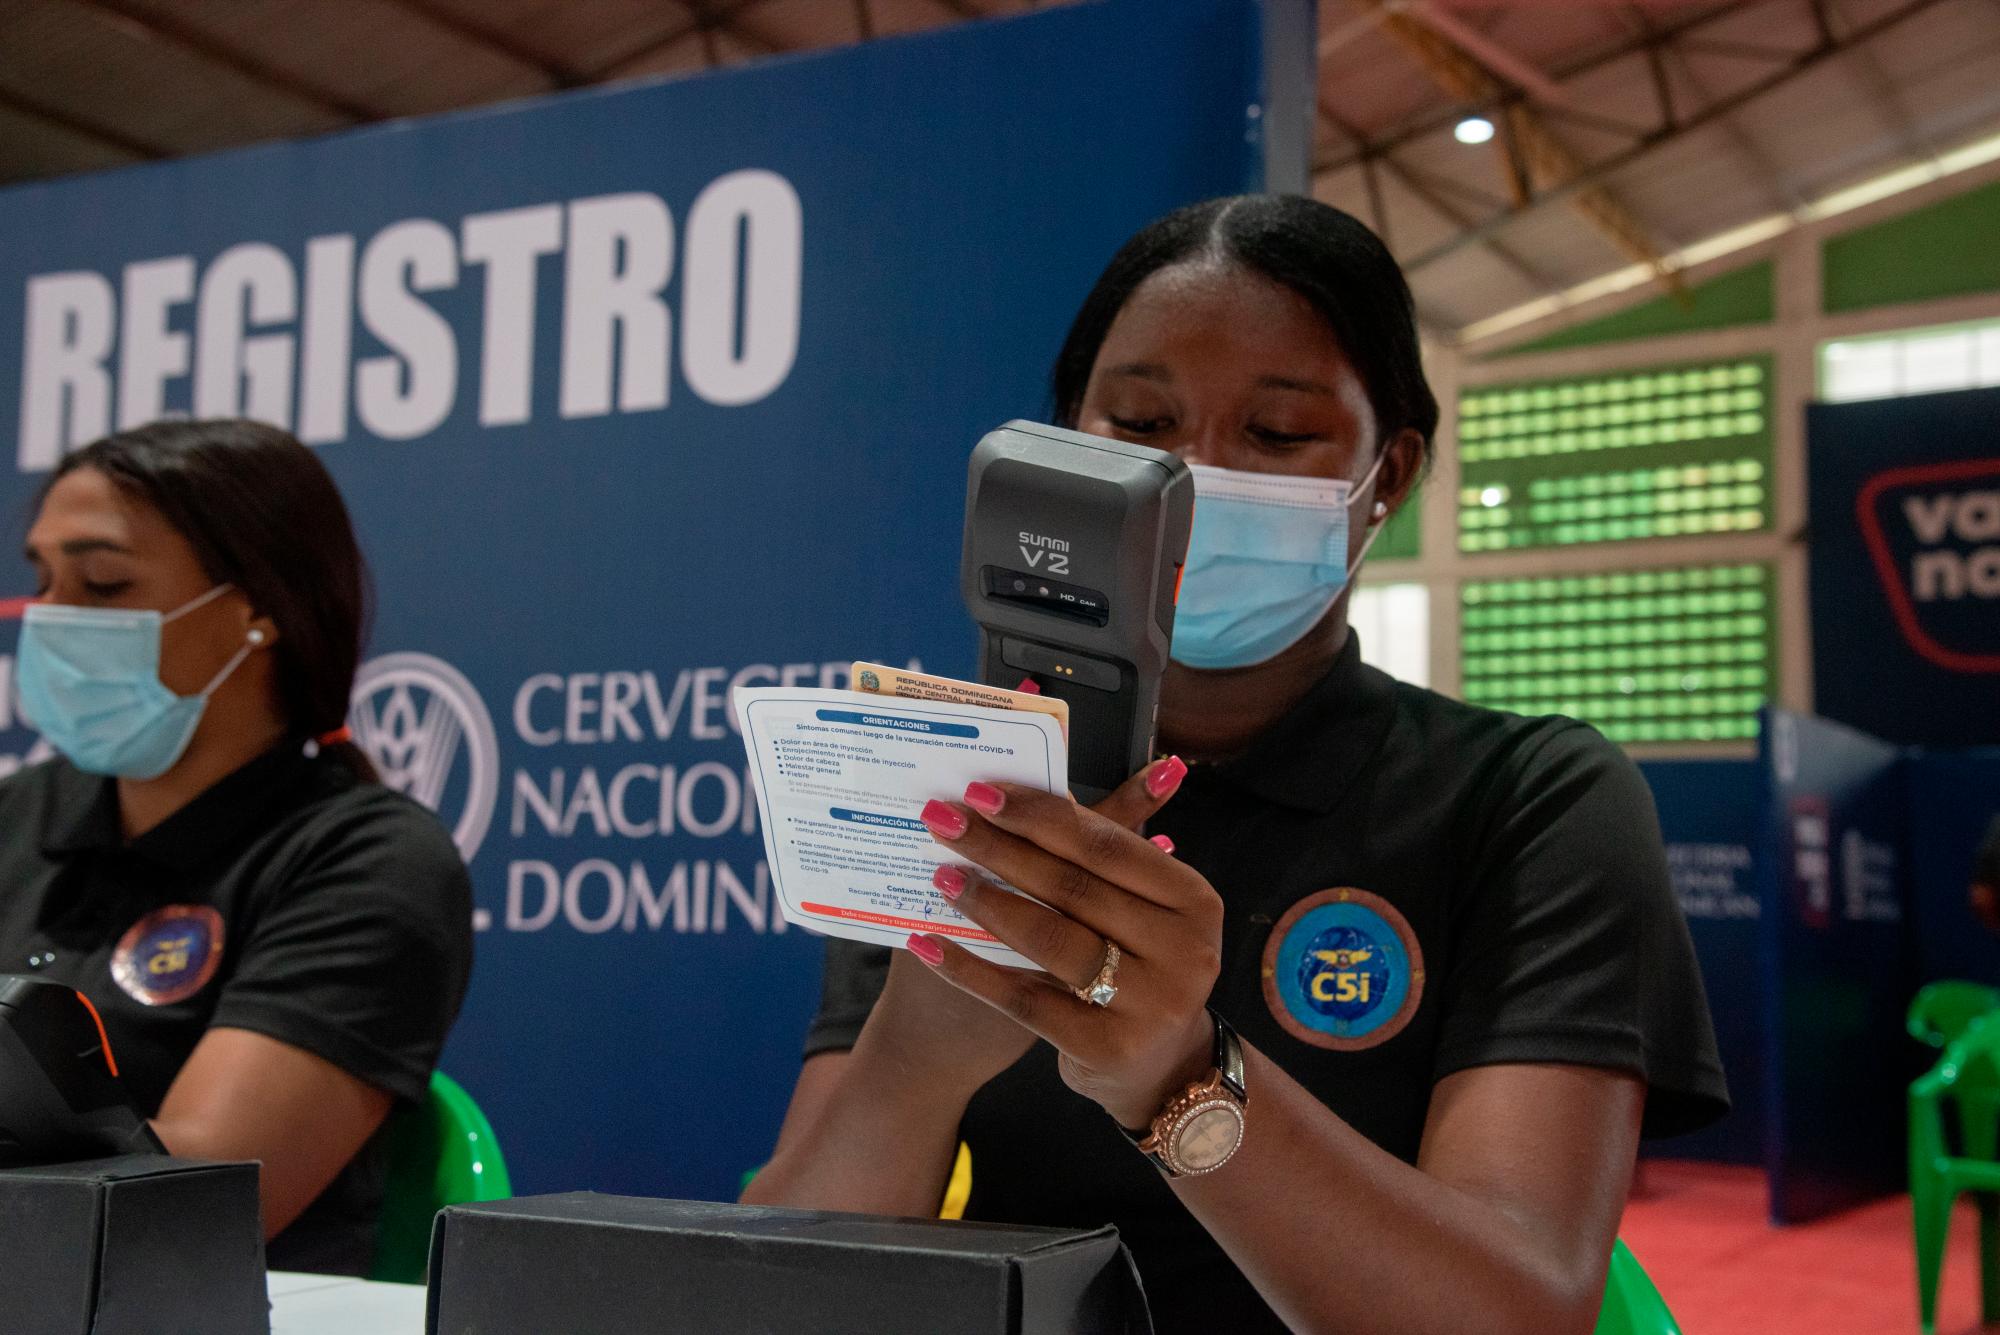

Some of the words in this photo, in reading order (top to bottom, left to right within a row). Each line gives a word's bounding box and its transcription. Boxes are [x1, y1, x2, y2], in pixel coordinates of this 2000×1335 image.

[17, 168, 803, 472] REGISTRO
[1019, 545, 1070, 575] V2
[1060, 592, 1076, 602] HD
[1079, 599, 1096, 607] CAM
[896, 684, 922, 694] JUNTA
[924, 690, 963, 704] CENTRAL
[951, 687, 1014, 705] DOMINICANA
[862, 715, 931, 732] ORIENTACIONES
[781, 738, 801, 746] Dolor
[840, 743, 874, 754] inyección
[831, 727, 862, 736] comunes
[863, 729, 884, 740] luego
[885, 733, 895, 741] de
[904, 736, 944, 747] vacunación
[945, 742, 969, 751] contra
[978, 744, 1014, 756] COVID-19
[782, 747, 836, 758] Enrojecimiento
[882, 759, 916, 769] inyección
[816, 758, 840, 767] cabeza
[785, 763, 814, 771] Malestar
[816, 767, 841, 776] general
[787, 771, 810, 779] Fiebre
[808, 821, 838, 830] garantizar
[845, 826, 877, 836] inmunidad
[851, 813, 909, 828] INFORMACIÓN
[814, 829, 844, 839] COVID-19
[859, 836, 882, 846] tiempo
[882, 840, 919, 850] establecido.
[813, 844, 841, 852] continuar
[863, 852, 890, 860] medidas
[819, 859, 850, 870] dispongan
[889, 863, 911, 871] lavado
[848, 887, 881, 898] Recuerde
[882, 893, 900, 901] estar
[900, 895, 924, 904] atento
[886, 884, 925, 897] Contacto:
